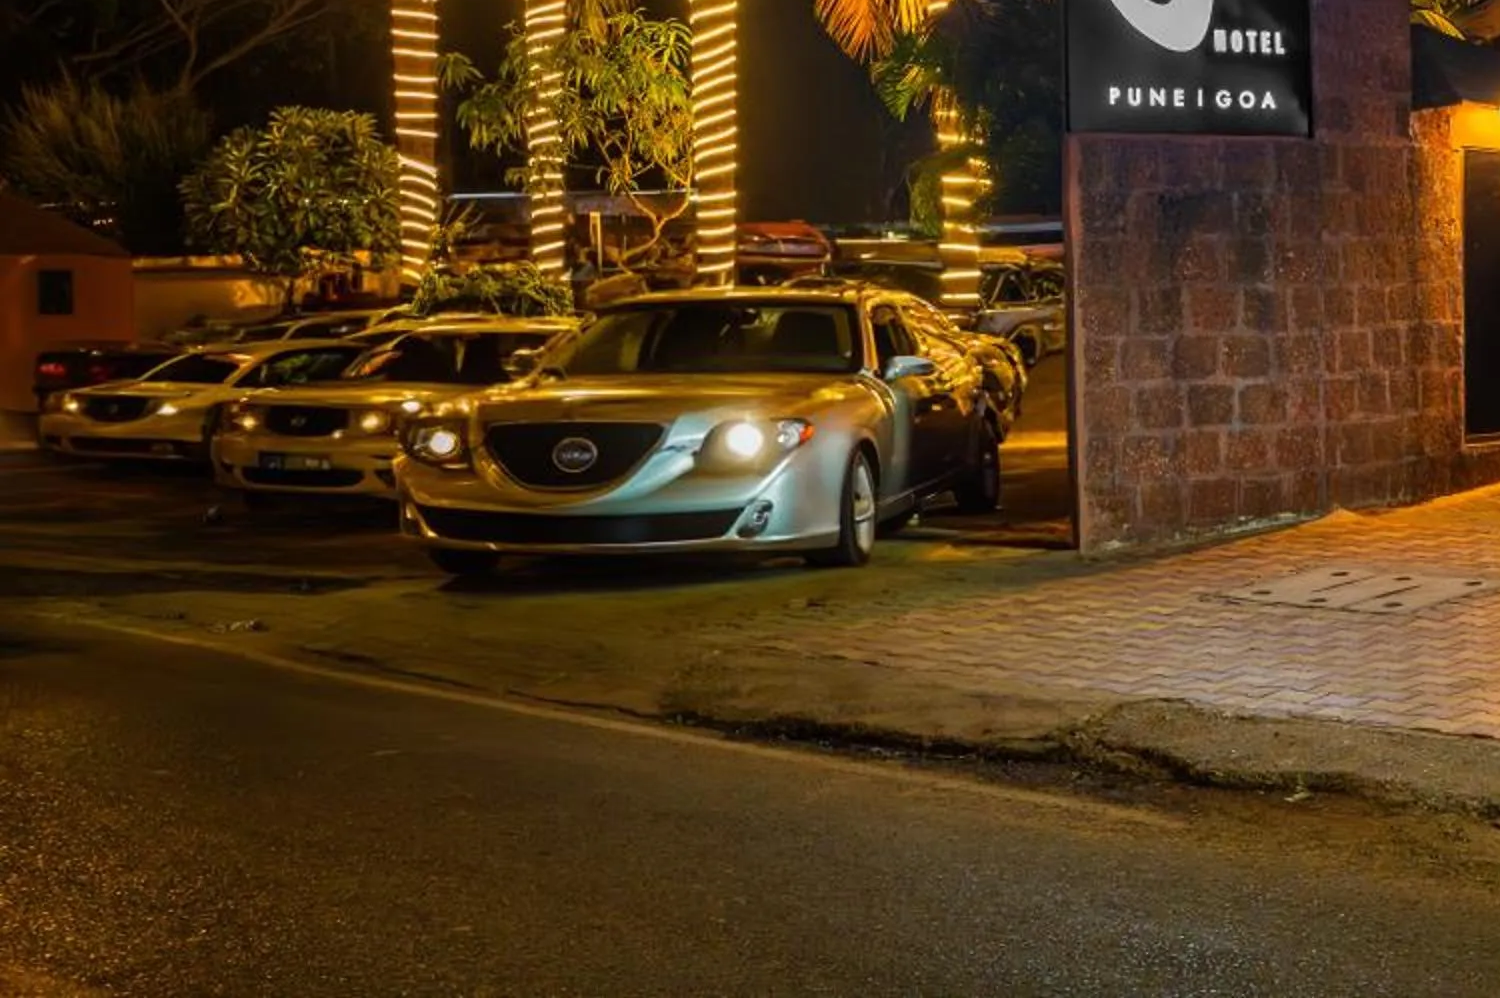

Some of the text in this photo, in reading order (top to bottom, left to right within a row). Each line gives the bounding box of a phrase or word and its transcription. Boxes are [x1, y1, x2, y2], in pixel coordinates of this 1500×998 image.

[1213, 29, 1285, 55] HOTEL
[1109, 87, 1185, 107] PUNE
[1215, 89, 1277, 109] GOA
